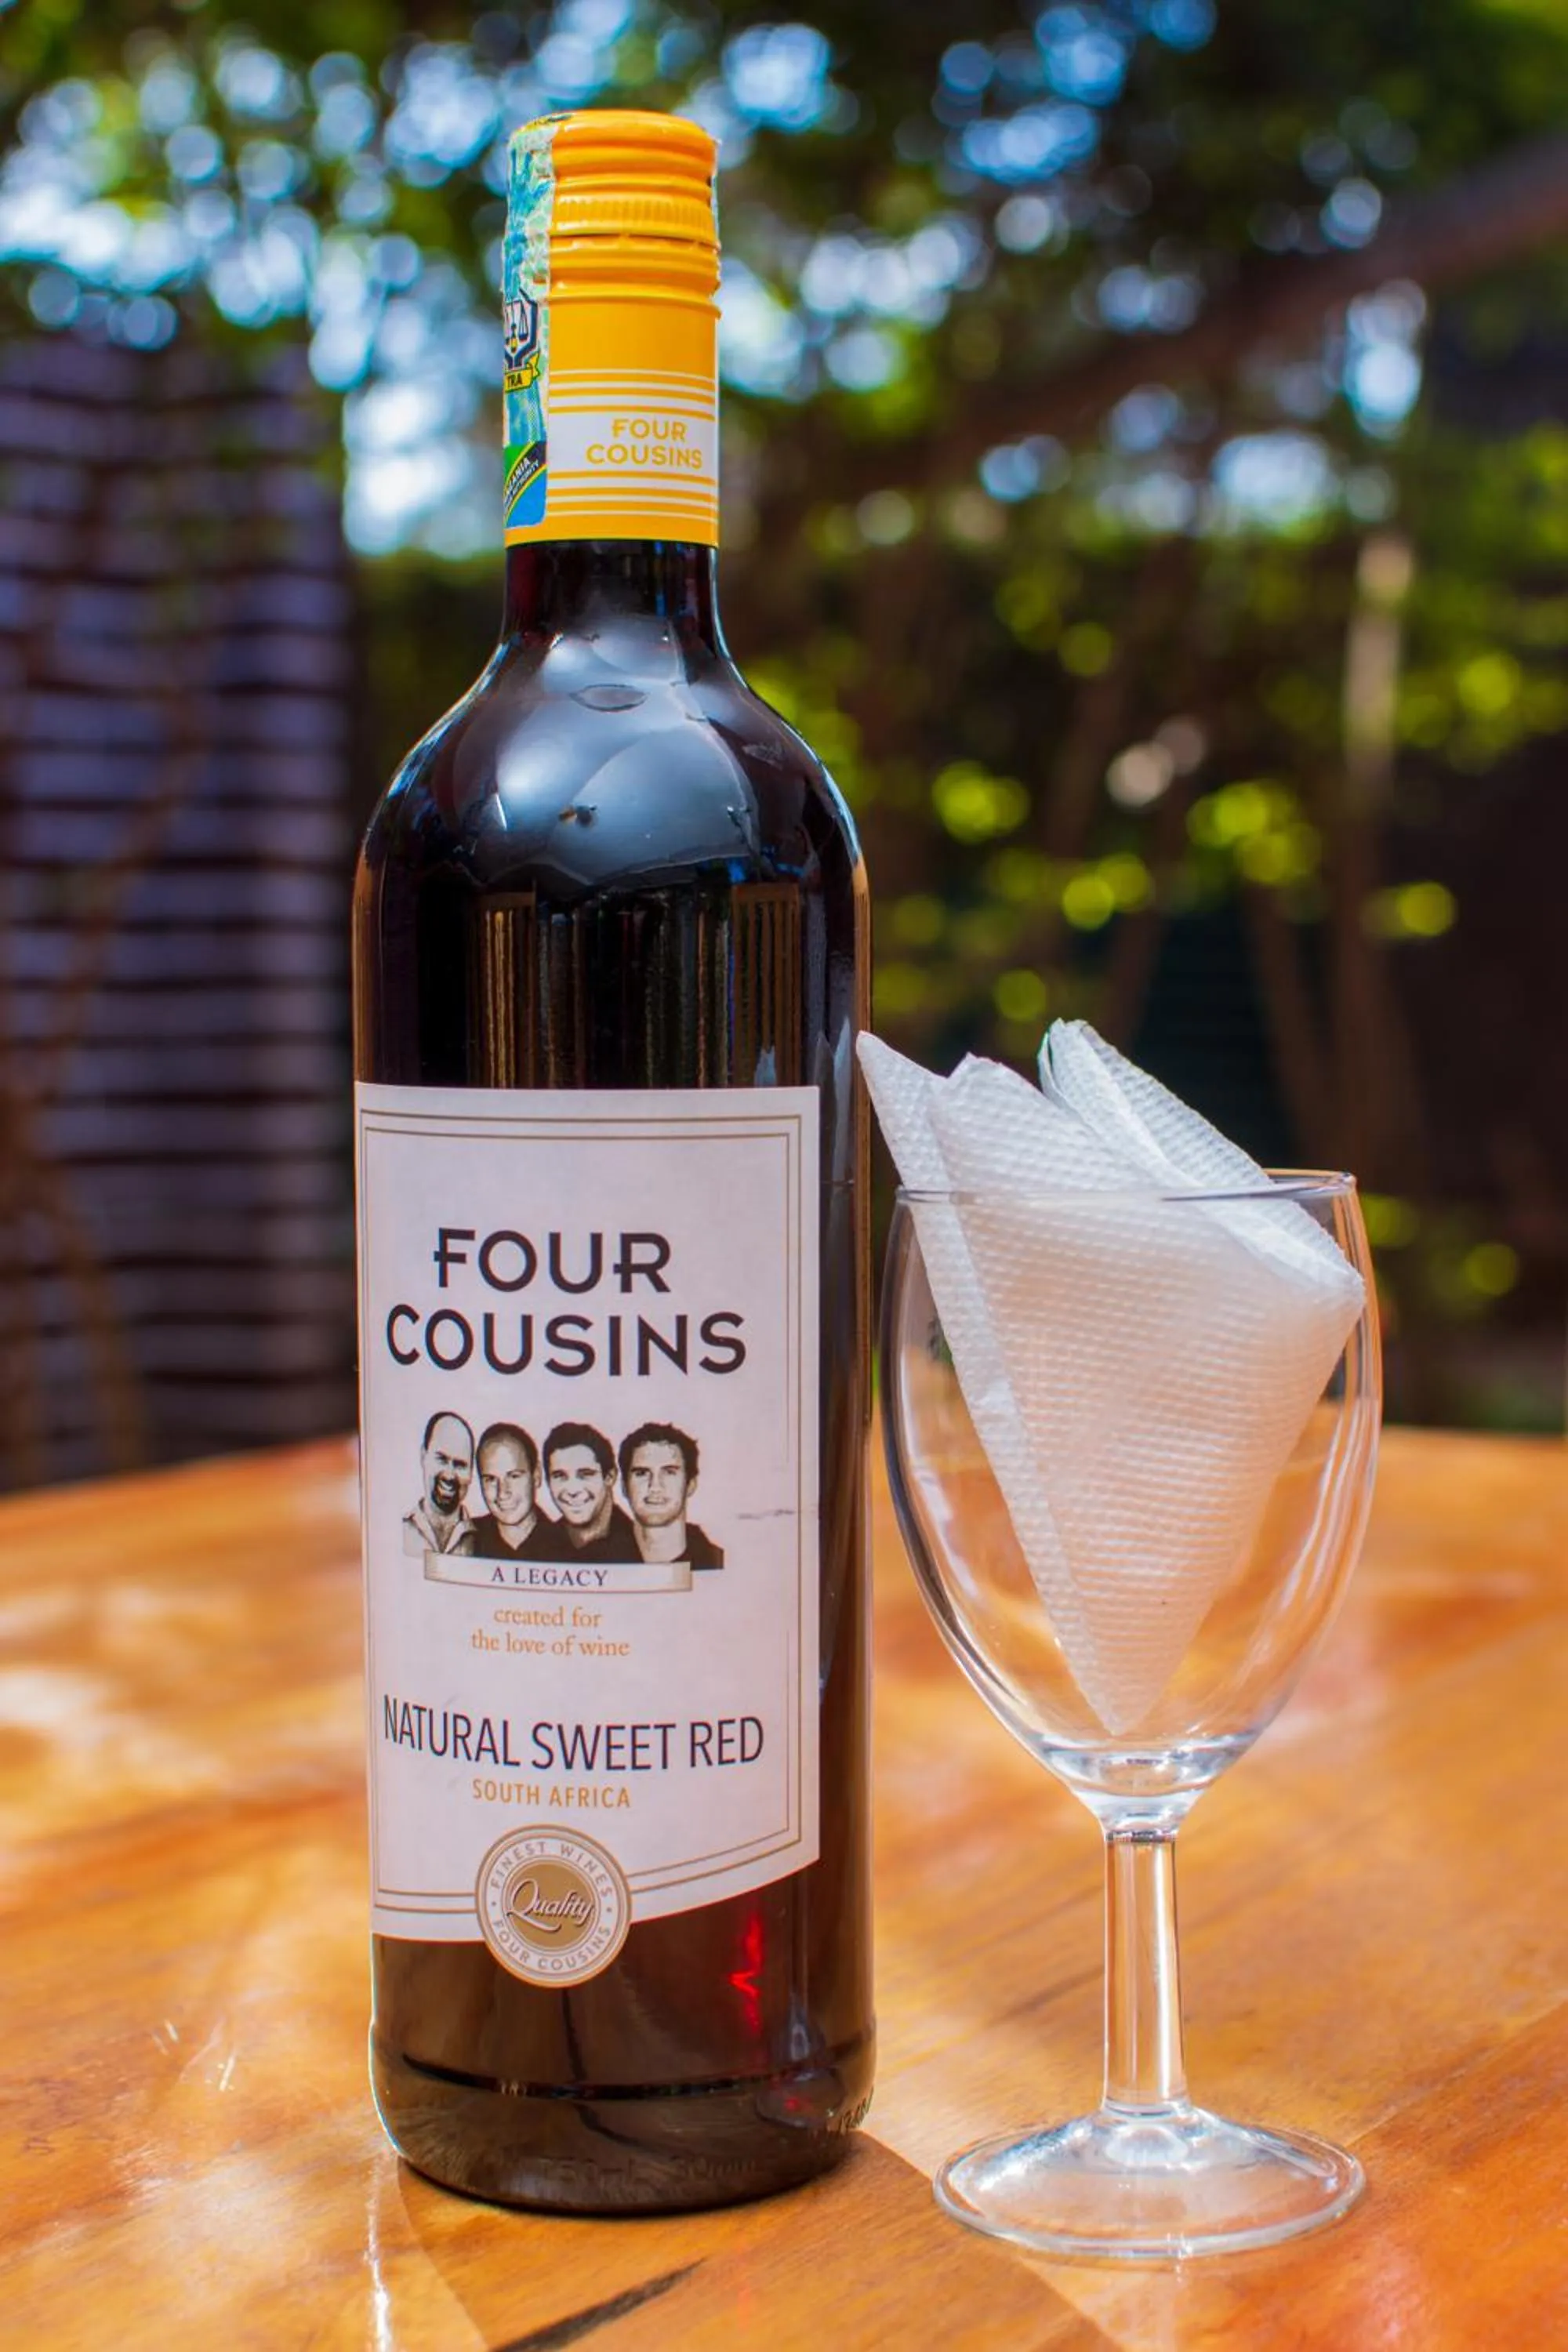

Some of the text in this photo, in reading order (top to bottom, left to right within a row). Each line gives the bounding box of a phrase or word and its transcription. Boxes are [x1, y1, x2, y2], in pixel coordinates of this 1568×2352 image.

[612, 418, 687, 443] FOUR
[586, 443, 702, 470] COUSINS
[434, 1228, 671, 1294] FOUR
[387, 1304, 746, 1377] COUSINS
[492, 1566, 608, 1586] A LEGACY
[493, 1606, 603, 1628] created for
[472, 1629, 630, 1657] the love of wine
[384, 1694, 764, 1771] NATURAL SWEET RED
[472, 1779, 631, 1809] SOUTH AFRICA
[490, 1841, 613, 1897] FINEST WINES
[506, 1878, 594, 1933] Quality
[493, 1919, 611, 1971] FOUR COUSINS
